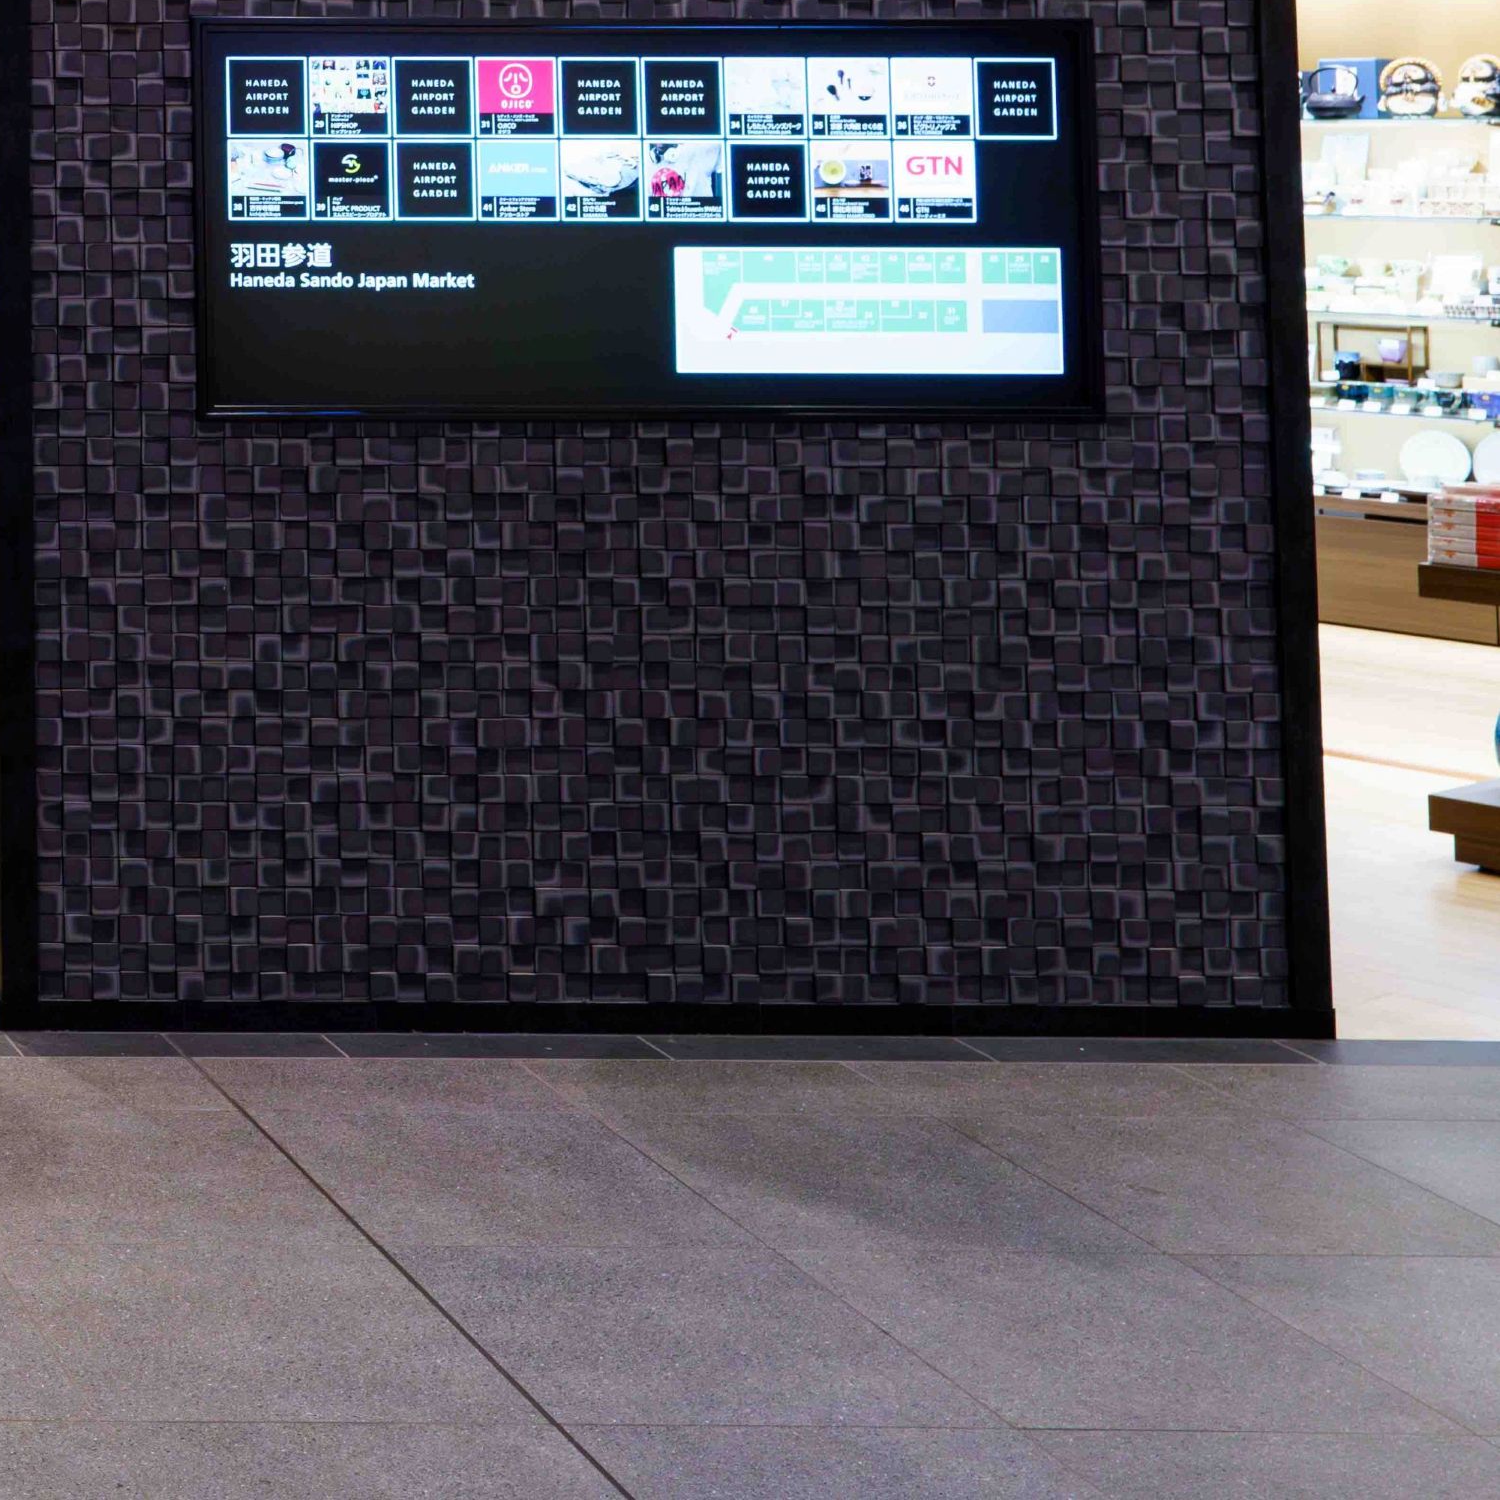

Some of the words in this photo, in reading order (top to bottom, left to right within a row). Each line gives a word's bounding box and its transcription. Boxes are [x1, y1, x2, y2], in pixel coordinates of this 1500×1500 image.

[245, 79, 288, 87] HANEDA
[411, 79, 454, 87] HANEDA
[577, 80, 621, 88] HANEDA
[661, 80, 704, 88] HANEDA
[993, 81, 1037, 89] HANEDA
[245, 93, 288, 101] AIRPORT
[411, 93, 454, 101] AIRPORT
[577, 93, 621, 101] AIRPORT
[661, 93, 704, 102] AIRPORT
[993, 94, 1037, 103] AIRPORT
[501, 100, 532, 109] OJICO
[245, 106, 290, 115] GARDEN
[411, 106, 456, 115] GARDEN
[577, 107, 622, 115] GARDEN
[661, 107, 706, 116] GARDEN
[993, 107, 1038, 117] GARDEN
[413, 162, 456, 170] HANEDA
[746, 163, 790, 171] HANEDA
[906, 156, 963, 176] GTN
[413, 176, 456, 184] AIRPORT
[746, 177, 790, 185] AIRPORT
[413, 189, 458, 198] GARDEN
[746, 190, 791, 199] GARDEN
[230, 242, 333, 268] 羽田参道
[230, 272, 295, 288] Haneda
[300, 272, 353, 288] Sando
[357, 272, 408, 291] Japan
[413, 272, 475, 288] Market
